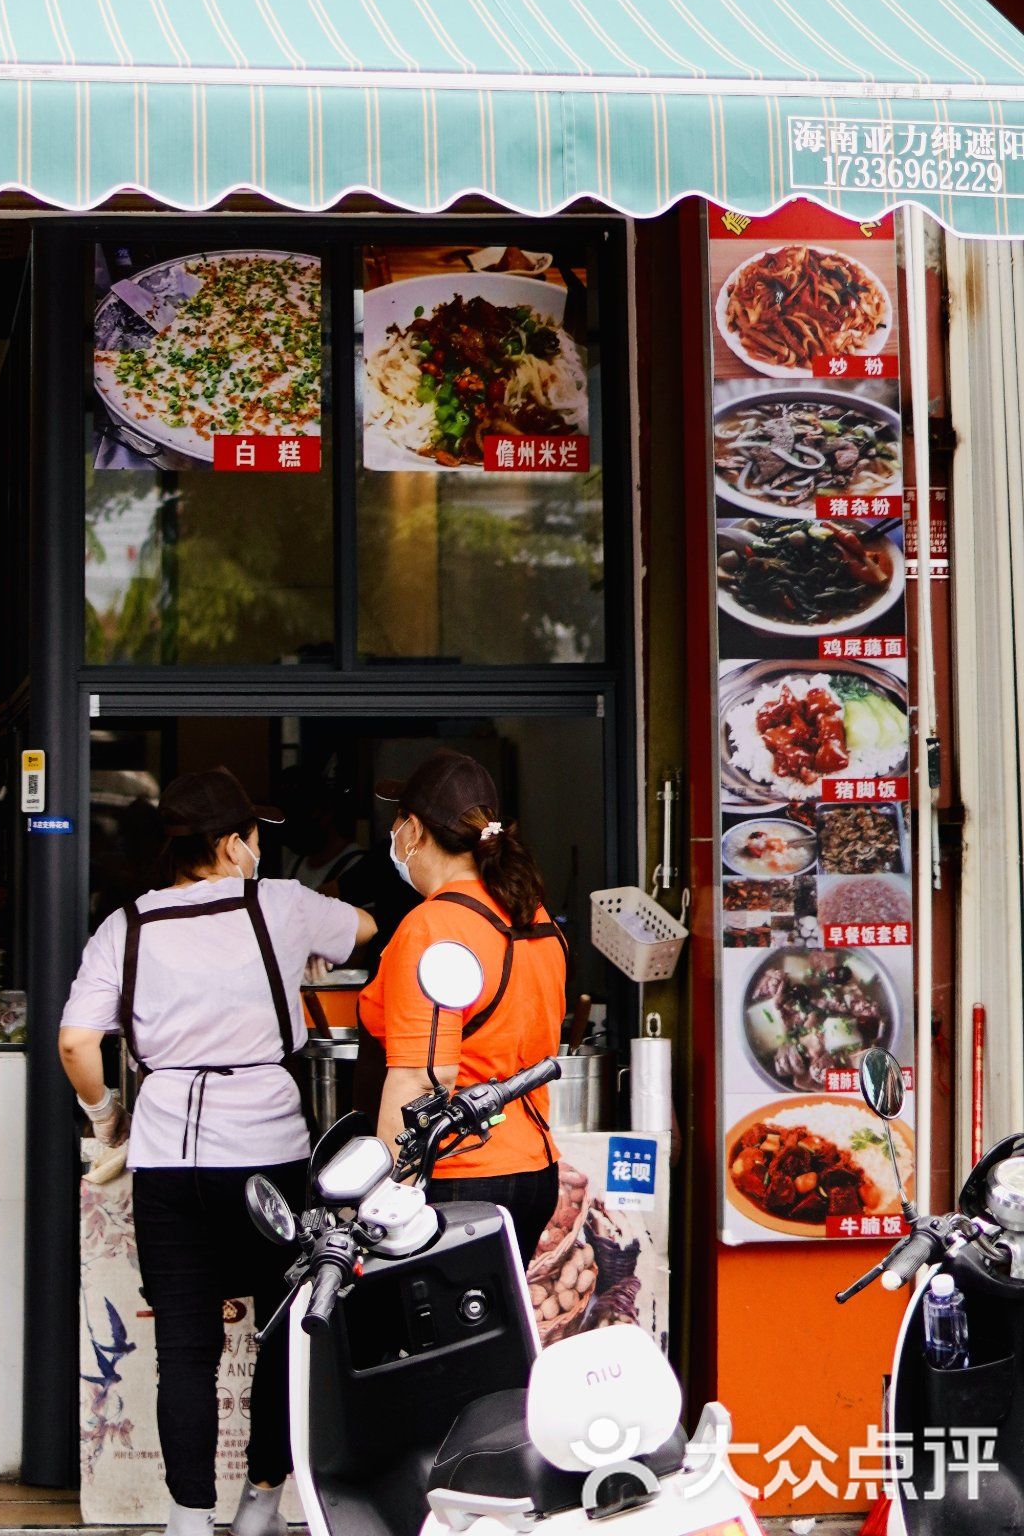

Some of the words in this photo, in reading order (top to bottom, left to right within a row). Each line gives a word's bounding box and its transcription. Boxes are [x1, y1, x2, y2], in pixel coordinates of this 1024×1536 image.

[823, 156, 1003, 192] 17336962229
[828, 357, 884, 376] 炒粉
[236, 439, 301, 468] 白糕
[496, 439, 578, 468] 儋州米烂
[829, 497, 891, 516] 猪杂粉
[834, 781, 897, 799] 猪脚饭
[828, 924, 908, 945] 早餐饭套餐
[611, 1160, 651, 1183] 花呗
[839, 1216, 902, 1236] 牛腩饭
